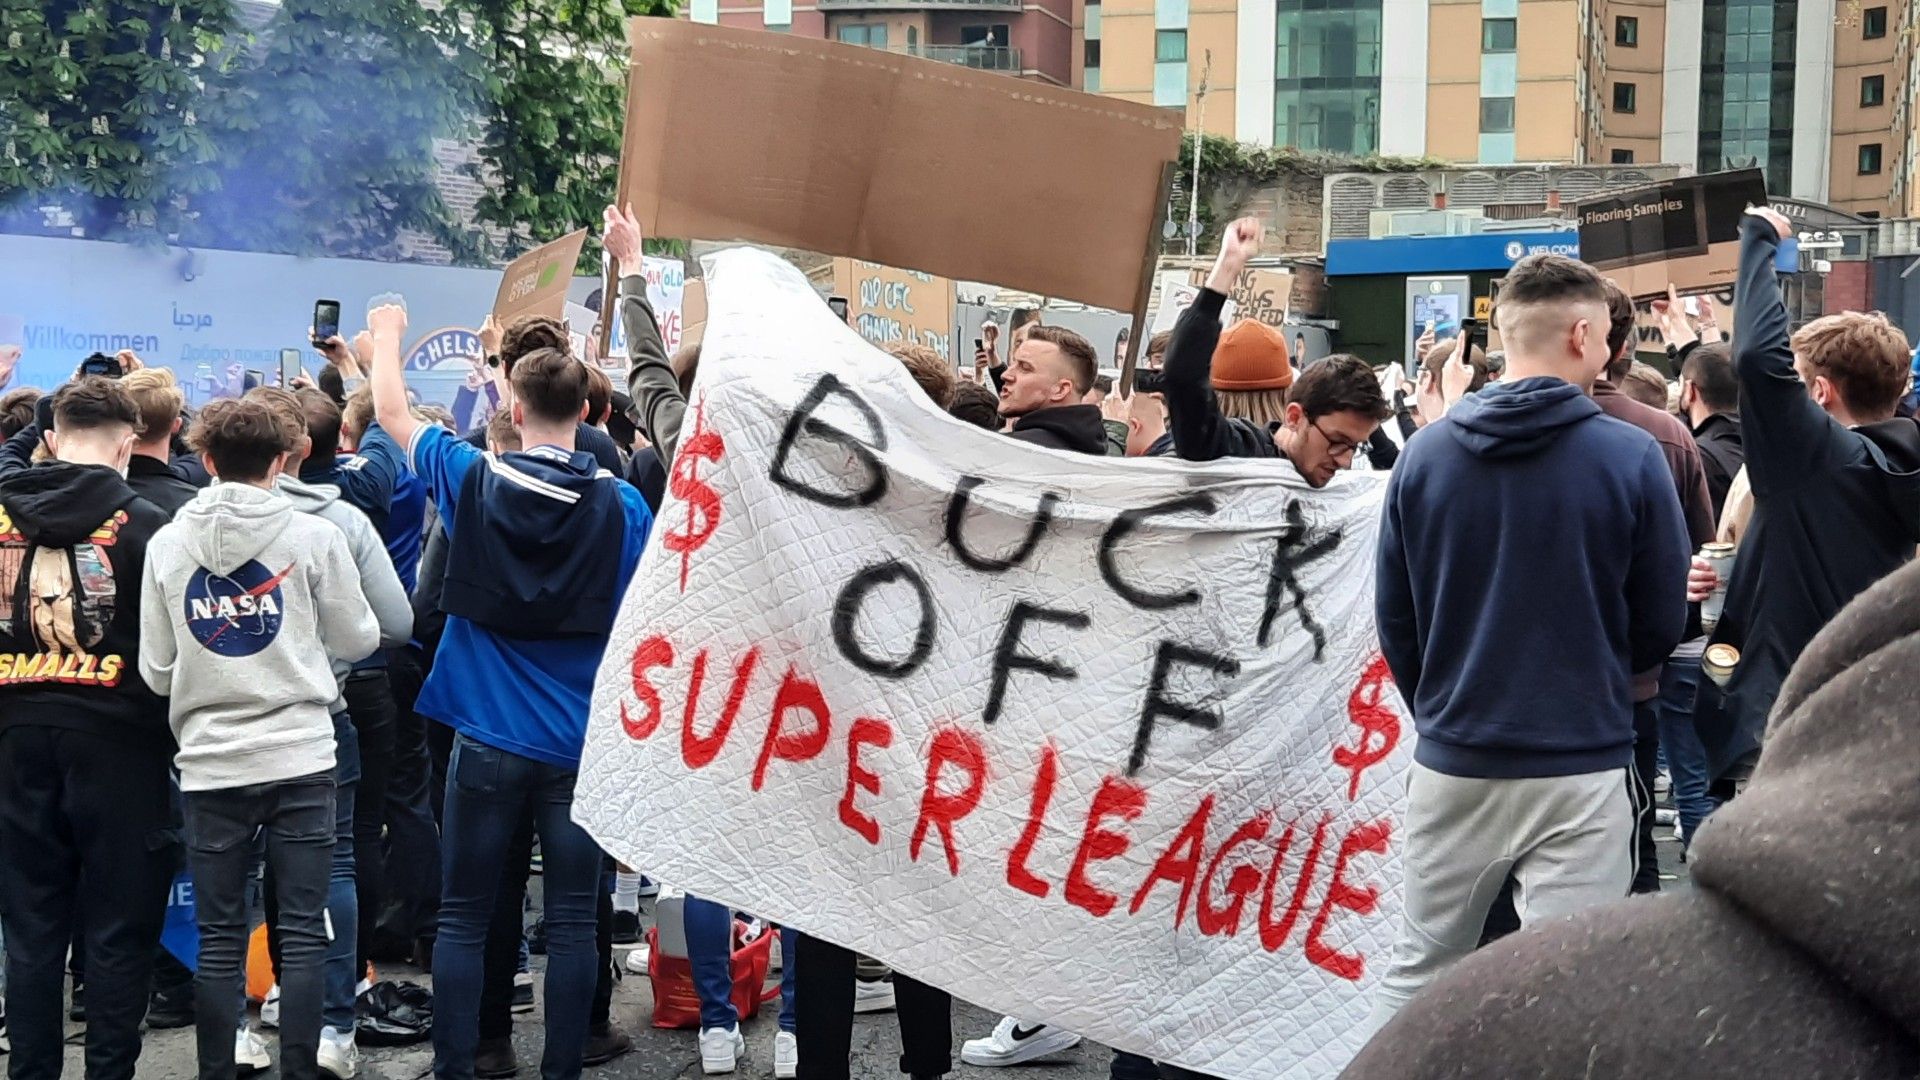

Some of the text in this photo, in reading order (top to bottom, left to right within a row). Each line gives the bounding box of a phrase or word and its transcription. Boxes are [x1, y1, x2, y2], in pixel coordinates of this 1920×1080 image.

[1586, 206, 1632, 225] Flooring
[1633, 199, 1683, 217] Samples
[1528, 245, 1578, 256] WELCOM
[661, 265, 684, 297] COLD
[860, 276, 881, 308] RIP
[884, 281, 914, 315] CFC
[856, 313, 904, 343] THANKS
[180, 343, 230, 362] Добро
[769, 373, 1342, 663] BUCK
[190, 592, 280, 620] NASA
[0, 653, 124, 687] SMALLS
[830, 558, 1241, 777] OFF
